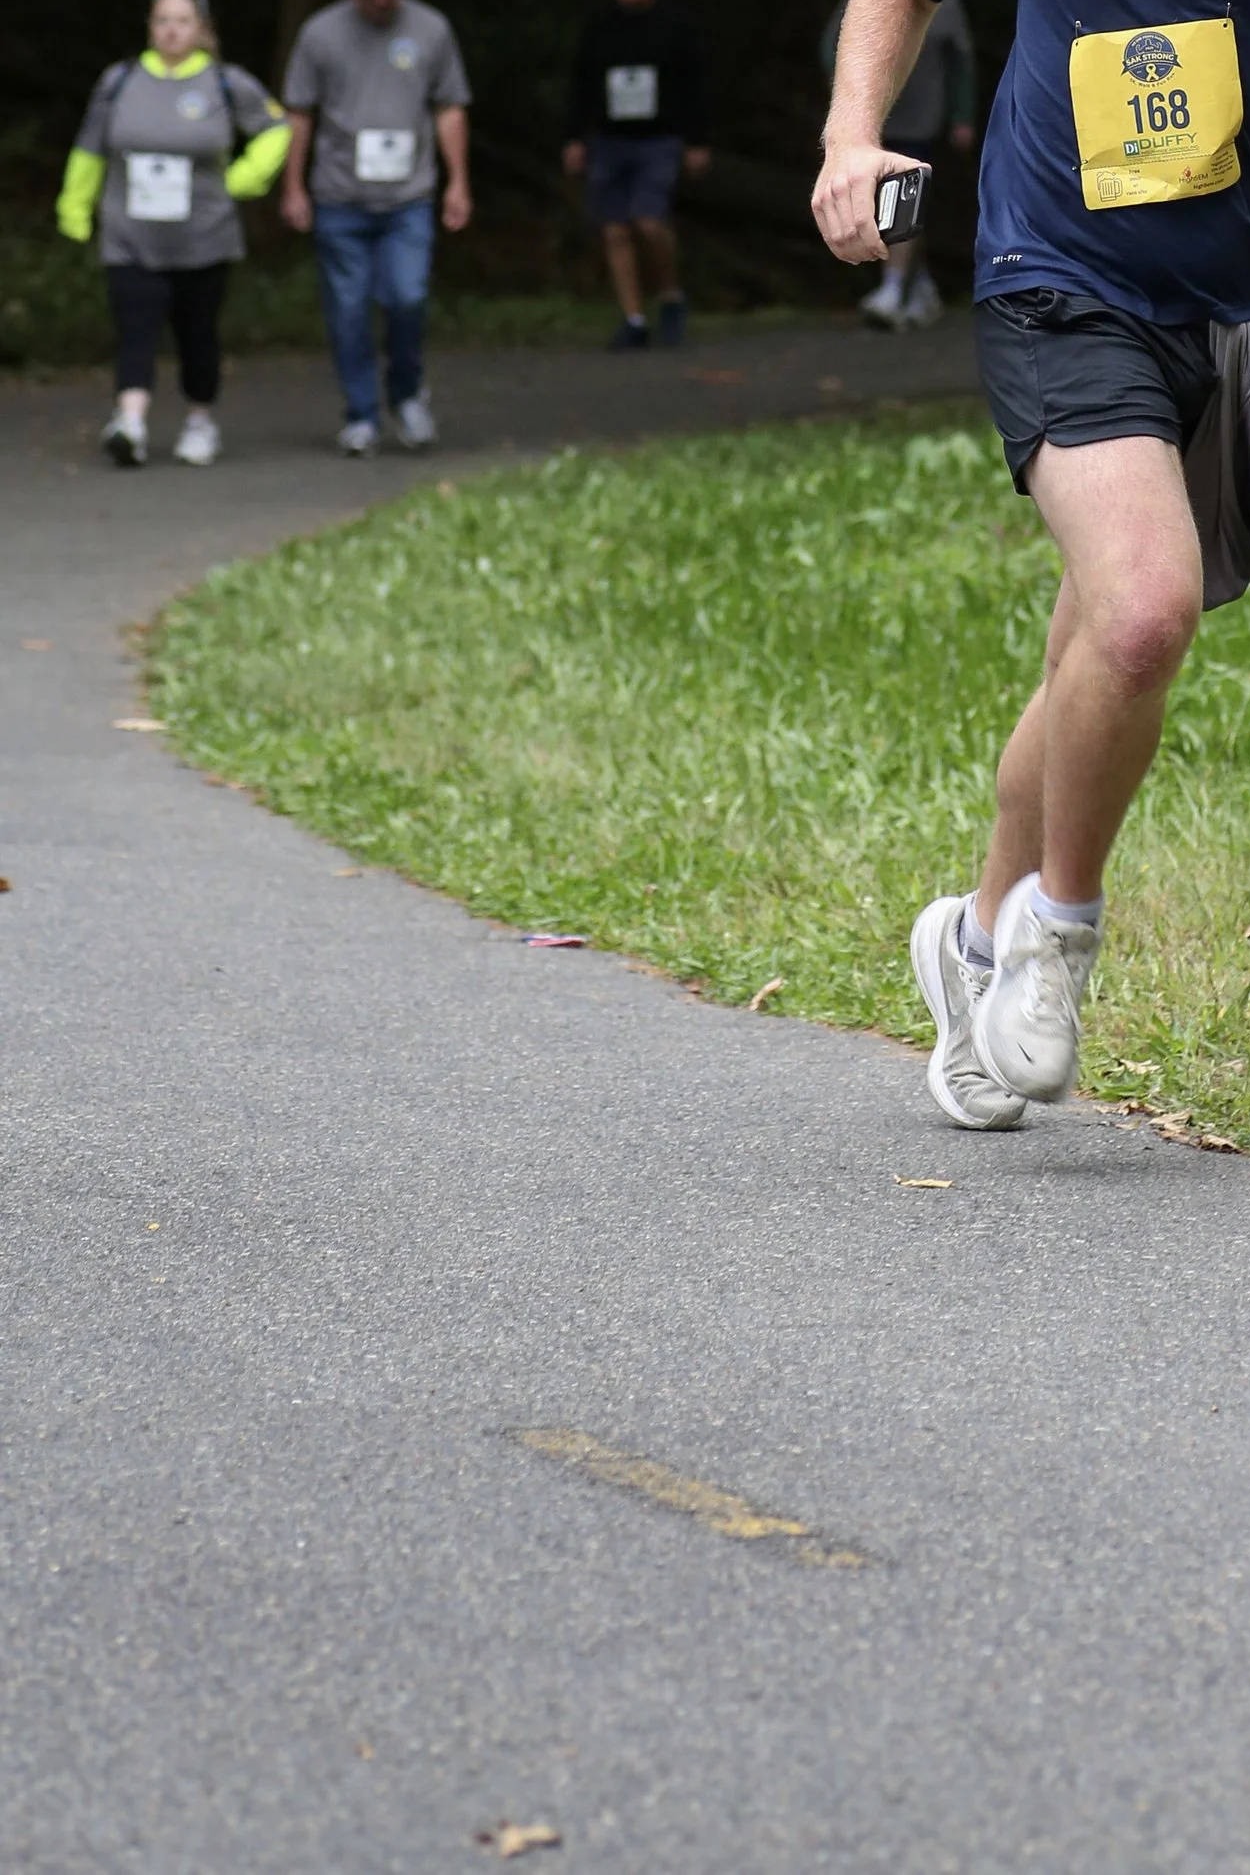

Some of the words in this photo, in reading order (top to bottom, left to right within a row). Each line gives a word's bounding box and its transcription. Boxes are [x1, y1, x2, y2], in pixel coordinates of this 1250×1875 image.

[1126, 55, 1142, 66] SAK
[1142, 53, 1174, 61] STRONG
[1127, 89, 1190, 134] 168
[1125, 142, 1138, 155] Di
[1140, 132, 1197, 149] DUFFY
[992, 254, 1023, 265] DRI-FIT
